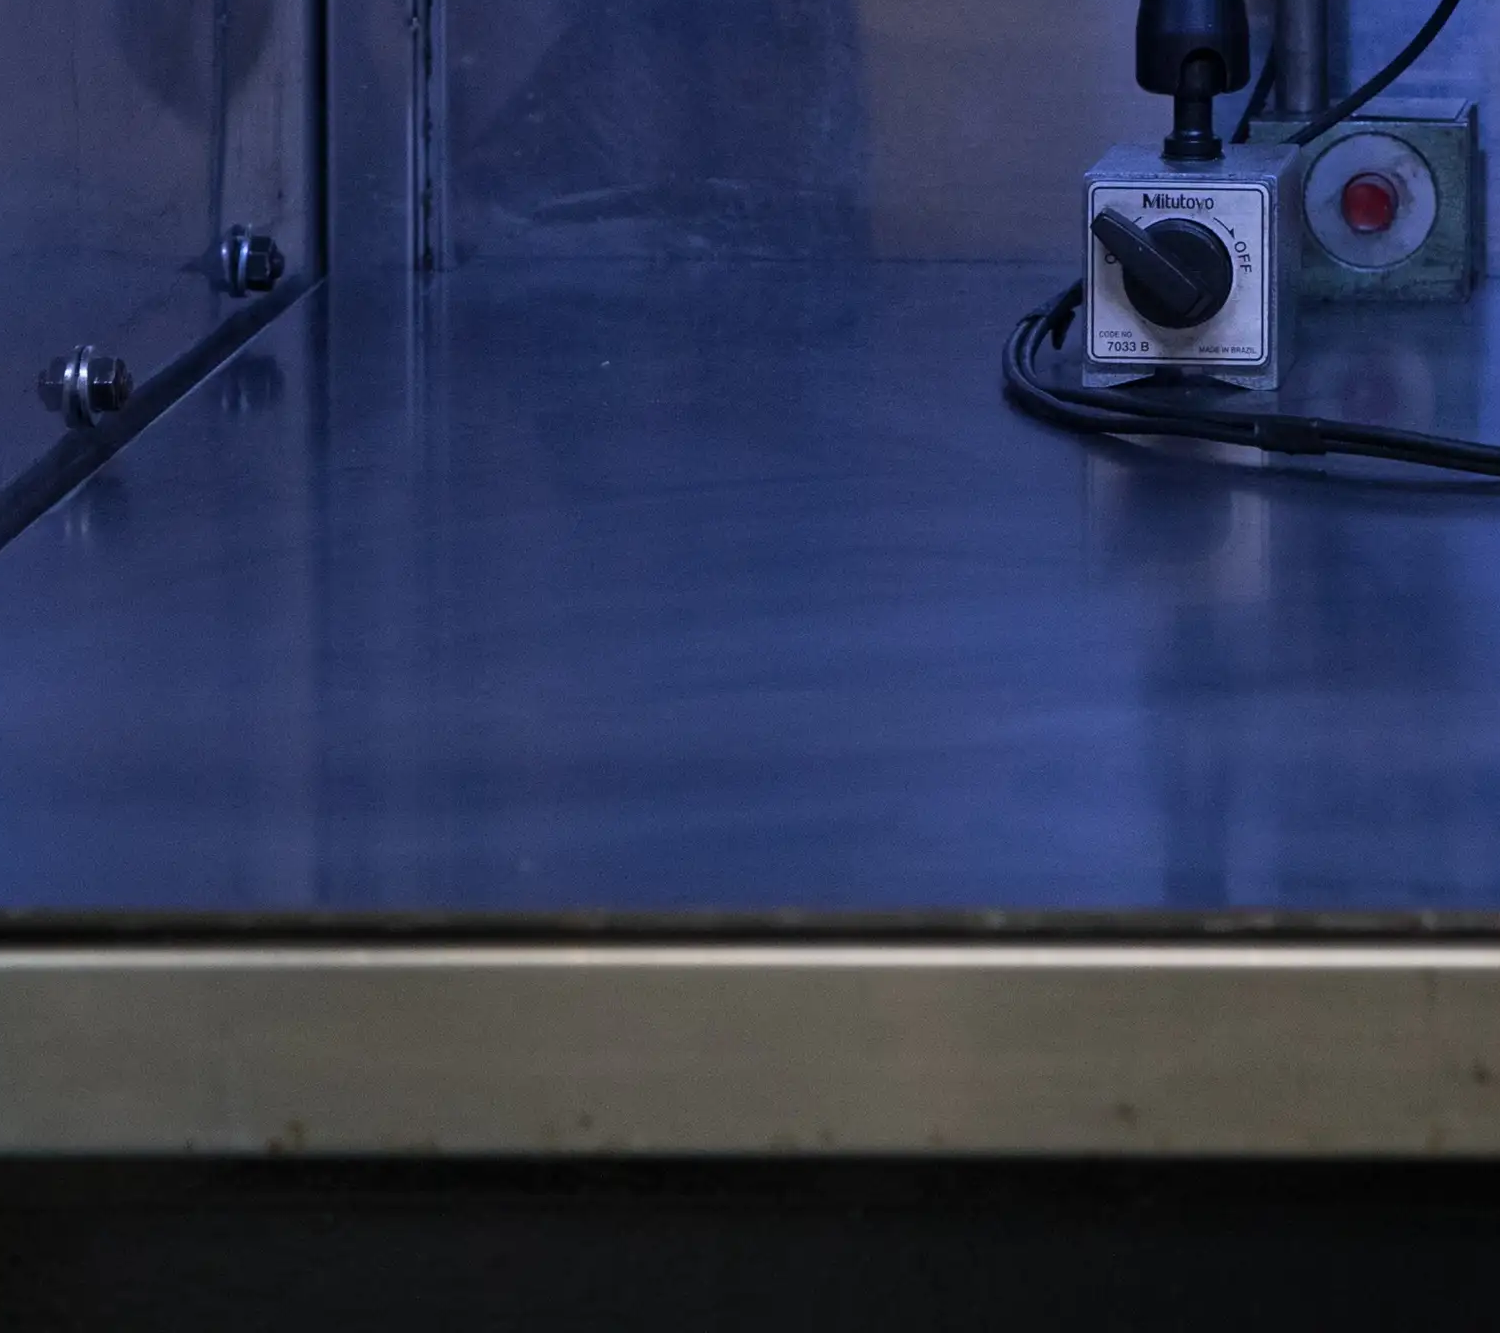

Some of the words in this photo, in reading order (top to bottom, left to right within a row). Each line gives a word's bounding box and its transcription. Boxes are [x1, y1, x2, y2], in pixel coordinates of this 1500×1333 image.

[1142, 193, 1215, 212] Mitutoyo
[1234, 241, 1252, 273] OFF
[1099, 330, 1120, 338] CODE
[1107, 341, 1136, 352] 7033
[1140, 341, 1150, 352] B
[1199, 346, 1220, 354] MADE
[1221, 346, 1230, 354] IN
[1230, 346, 1258, 355] BRAZIL
